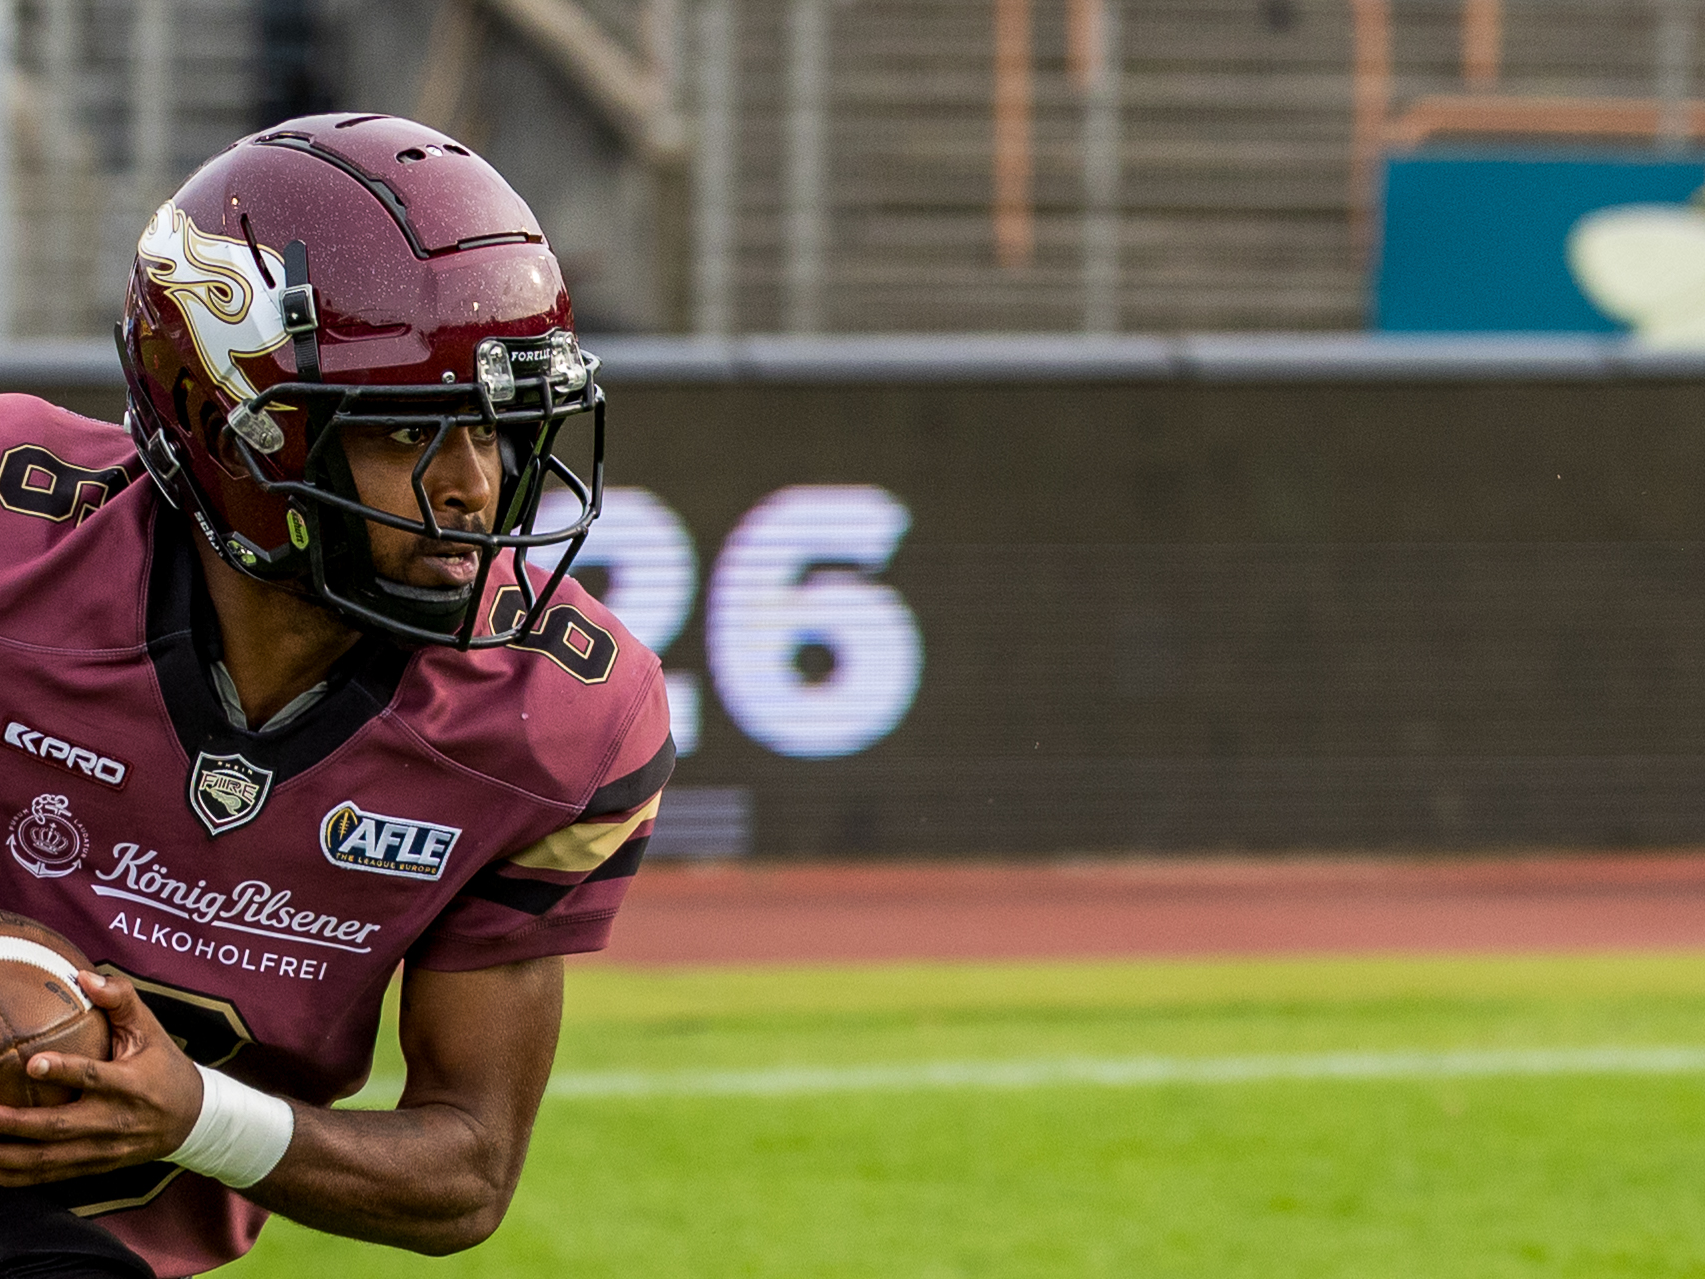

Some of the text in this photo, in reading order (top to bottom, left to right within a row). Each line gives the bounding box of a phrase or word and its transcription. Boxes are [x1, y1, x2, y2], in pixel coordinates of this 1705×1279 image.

[335, 852, 355, 862] THE
[358, 856, 396, 869] LEAGUE
[337, 817, 452, 867] AFLE
[95, 842, 382, 944] König Pilsener
[108, 911, 328, 981] ALKOHOLFREI
